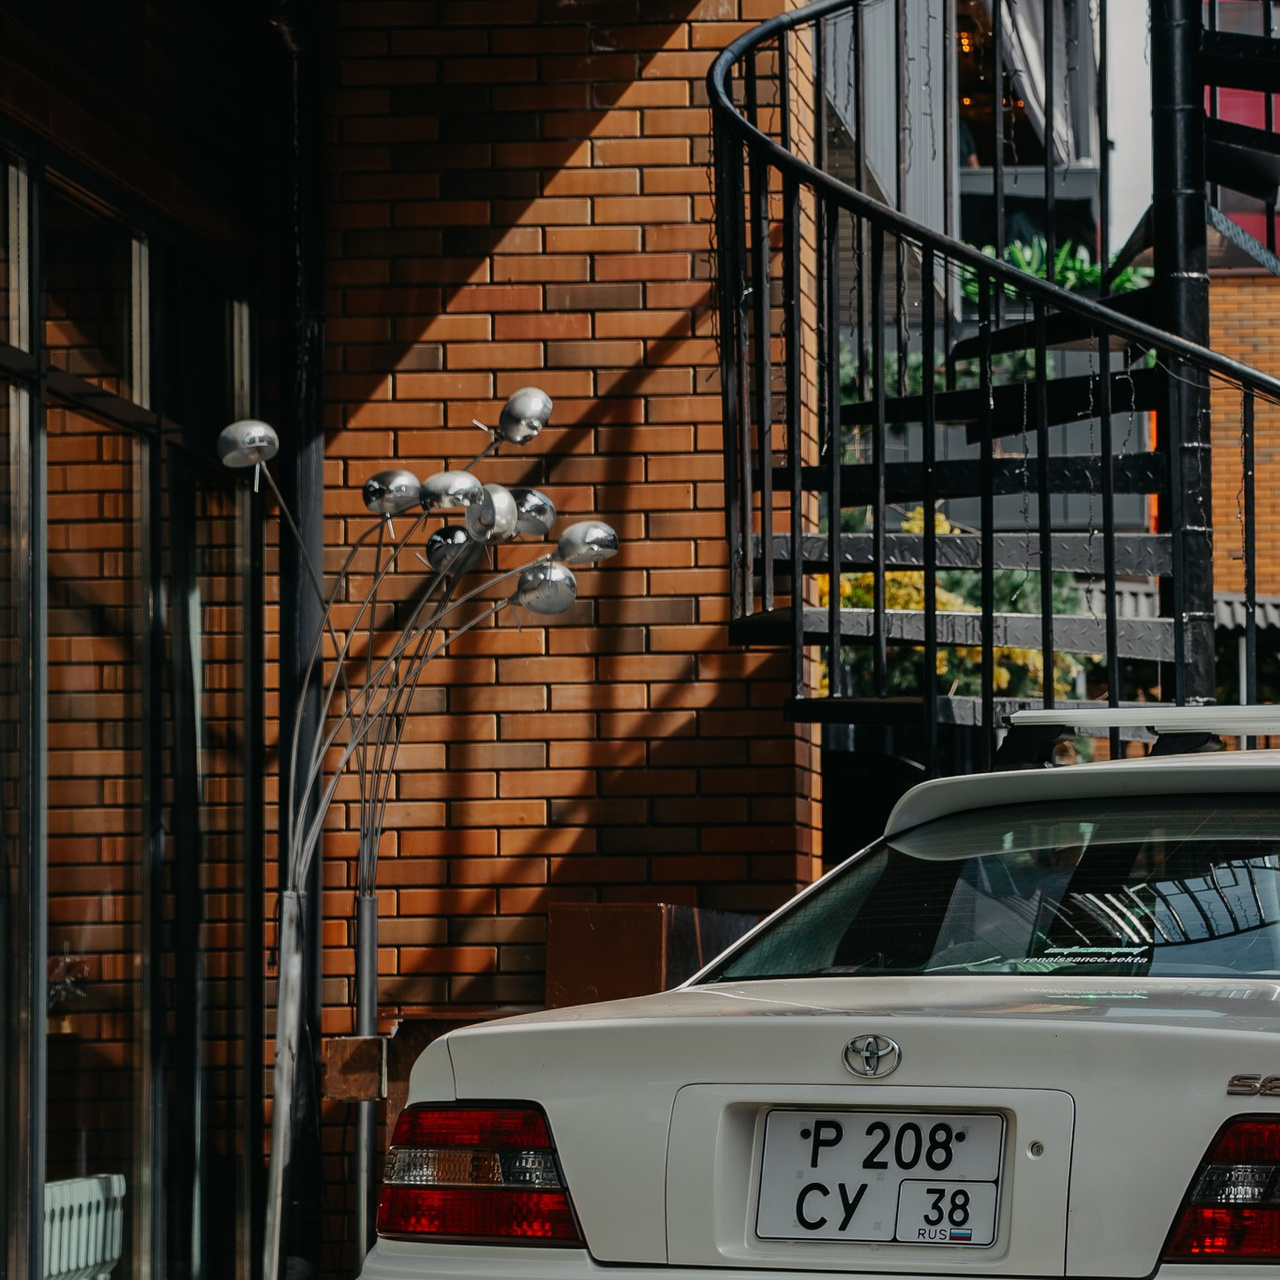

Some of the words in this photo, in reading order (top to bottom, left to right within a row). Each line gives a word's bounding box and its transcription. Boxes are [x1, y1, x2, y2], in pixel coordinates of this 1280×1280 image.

[811, 1120, 843, 1168] Р
[862, 1121, 953, 1171] 208
[796, 1182, 868, 1231] СУ
[923, 1188, 970, 1227] 38
[917, 1228, 947, 1240] RUS
